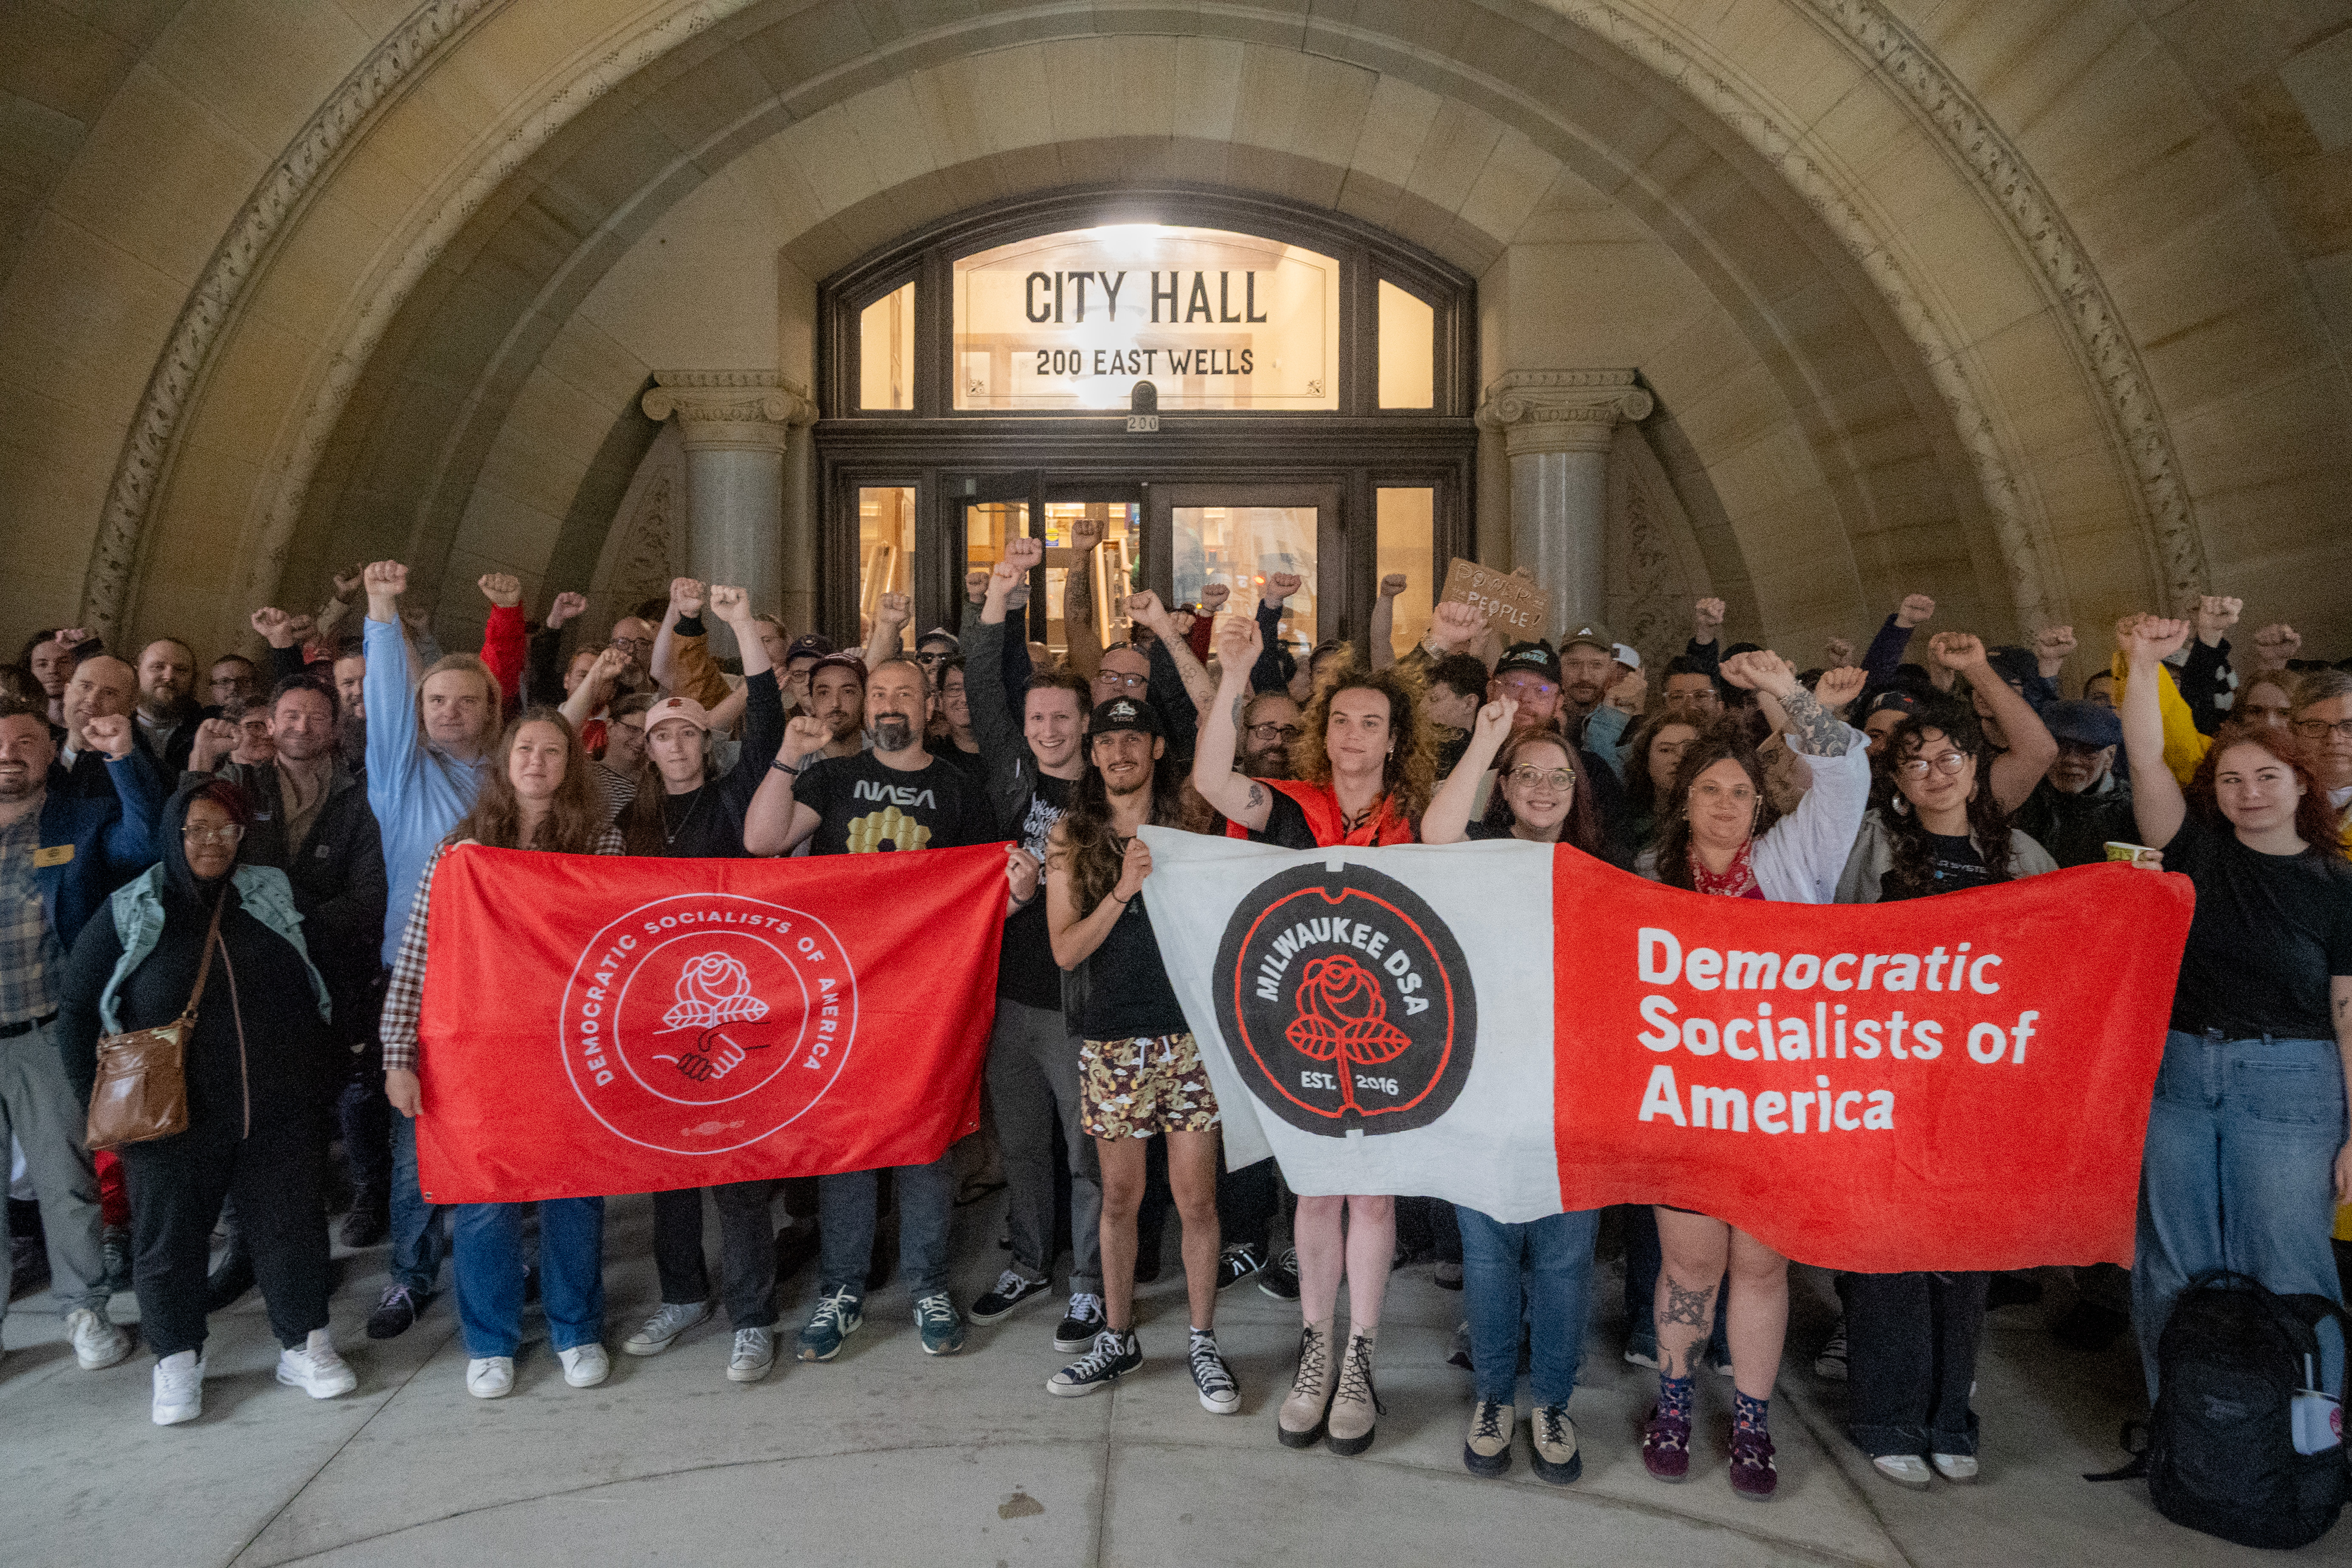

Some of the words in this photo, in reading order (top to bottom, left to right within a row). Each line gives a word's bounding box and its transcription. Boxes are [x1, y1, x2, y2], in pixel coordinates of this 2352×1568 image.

[1025, 271, 1128, 323] CITY
[1150, 271, 1267, 323] HALL
[1037, 349, 1081, 375] 200
[1094, 349, 1157, 375] EAST
[1167, 349, 1253, 375] WELLS
[1128, 417, 1156, 430] 200
[1455, 563, 1531, 601] POWER
[853, 779, 937, 810] NASA
[643, 911, 792, 934] SOCIALISTS
[797, 936, 826, 964] OF
[1256, 917, 1390, 1002] MILWAUKEE
[1383, 949, 1430, 1016] DSA
[1637, 926, 2003, 995] Democratic
[581, 933, 637, 1087] DEMOCRATIC
[803, 977, 839, 1071] AMERICA
[1637, 994, 1944, 1061] Socialists
[1966, 1010, 2040, 1065] of
[1300, 1071, 1337, 1090] EST.
[1355, 1074, 1399, 1096] 2016
[1638, 1064, 1895, 1134] America
